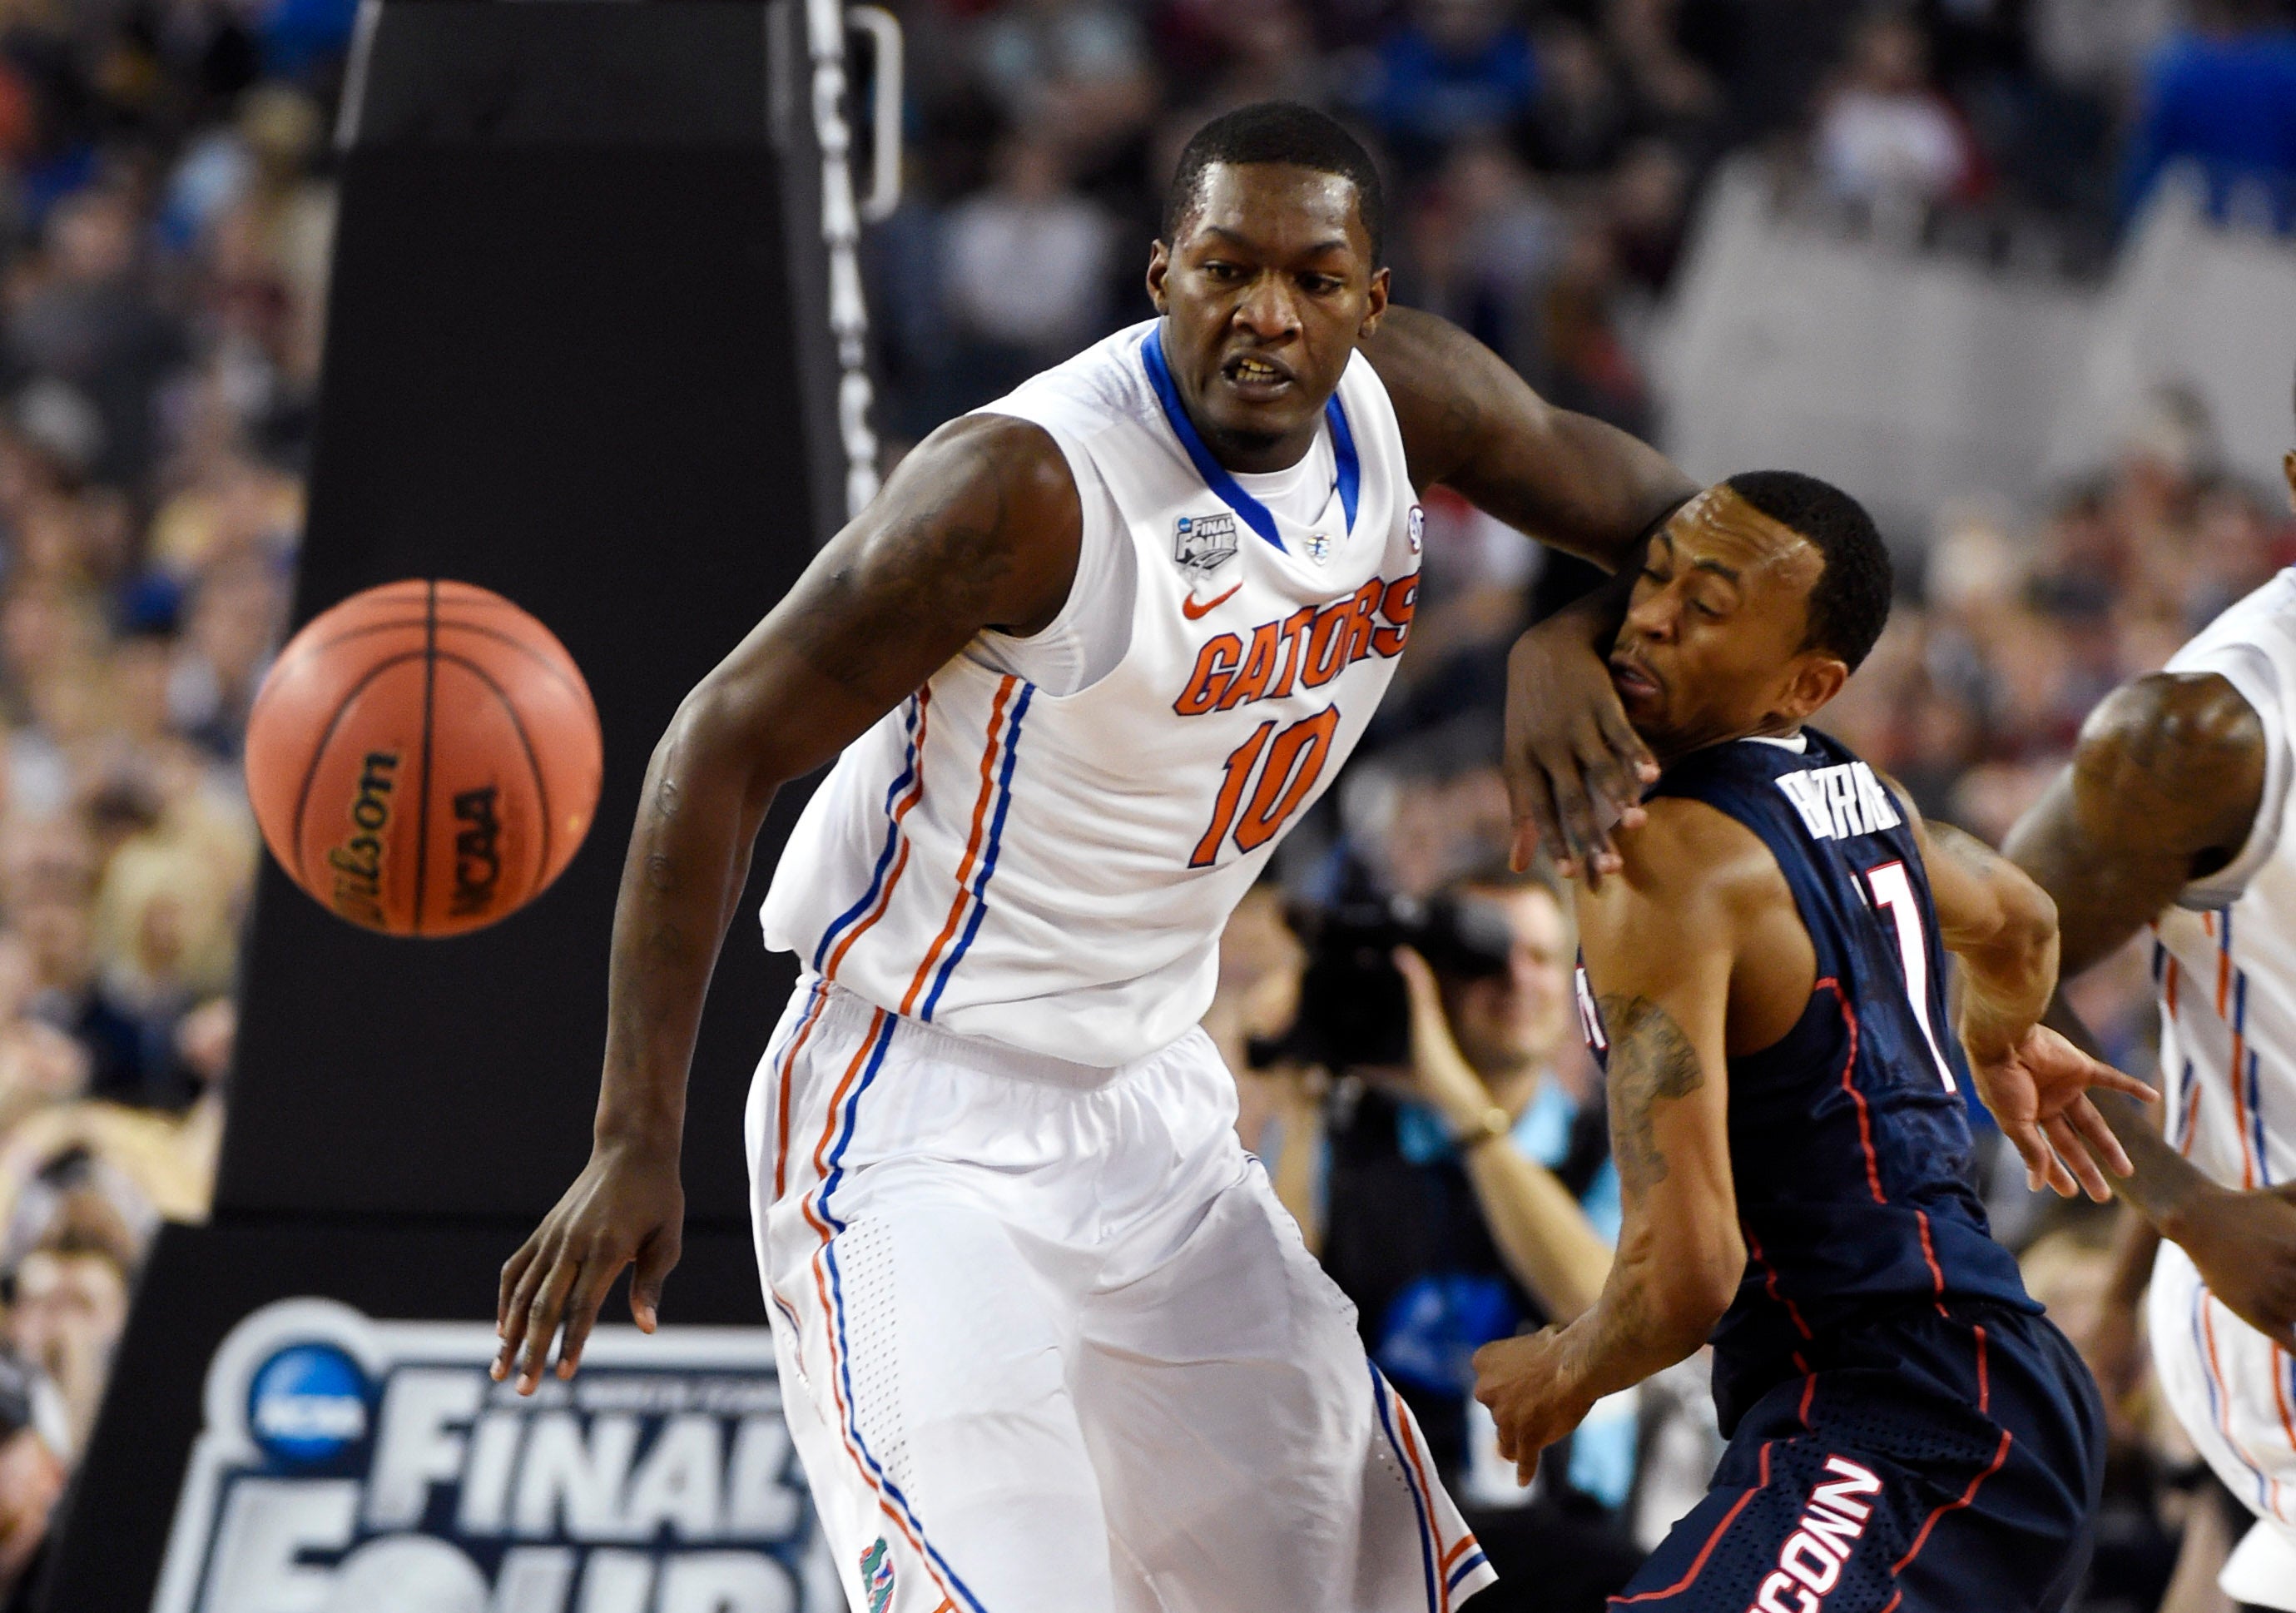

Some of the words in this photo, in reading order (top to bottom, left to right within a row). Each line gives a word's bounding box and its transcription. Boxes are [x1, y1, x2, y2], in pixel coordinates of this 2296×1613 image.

[1191, 518, 1236, 536] FINAL
[1173, 566, 1419, 716] GATORS
[1188, 702, 1340, 868] 10
[362, 1367, 801, 1541] FINAL
[1745, 1453, 1883, 1613] CONN
